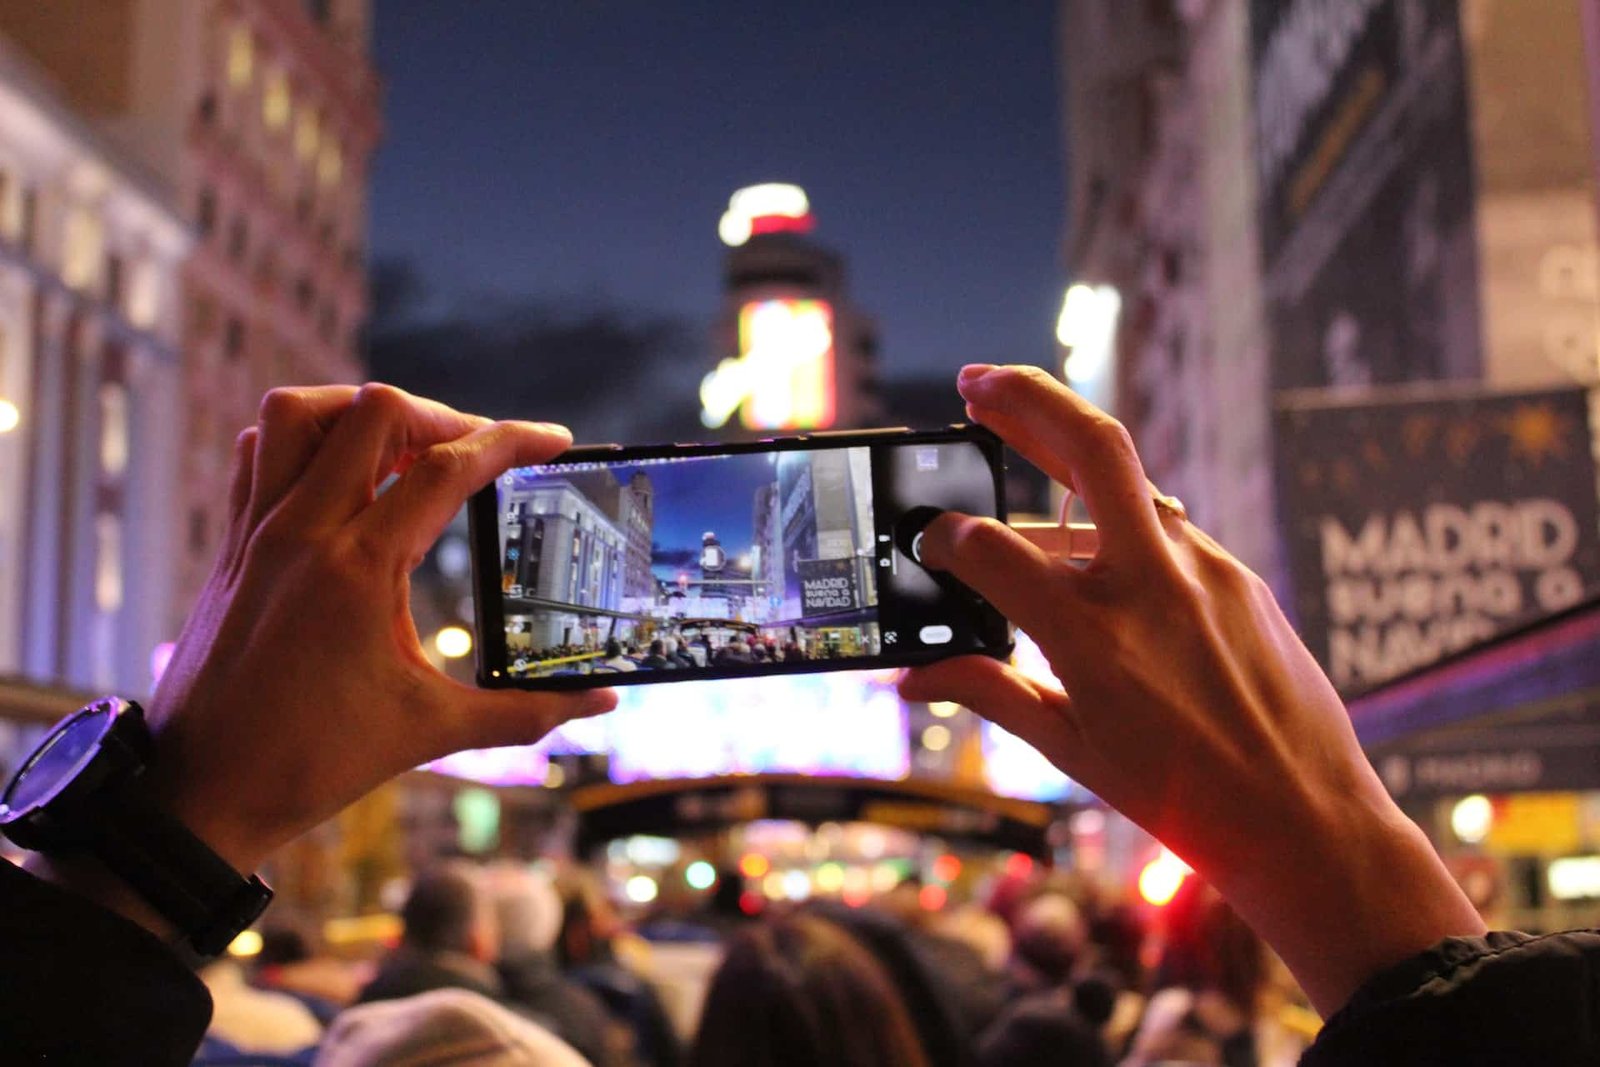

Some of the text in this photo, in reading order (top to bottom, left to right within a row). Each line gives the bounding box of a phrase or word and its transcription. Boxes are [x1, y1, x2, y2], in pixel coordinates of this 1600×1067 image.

[1320, 499, 1578, 575] MADRID
[804, 577, 849, 590] MADRID
[805, 596, 851, 608] NAVIDAD
